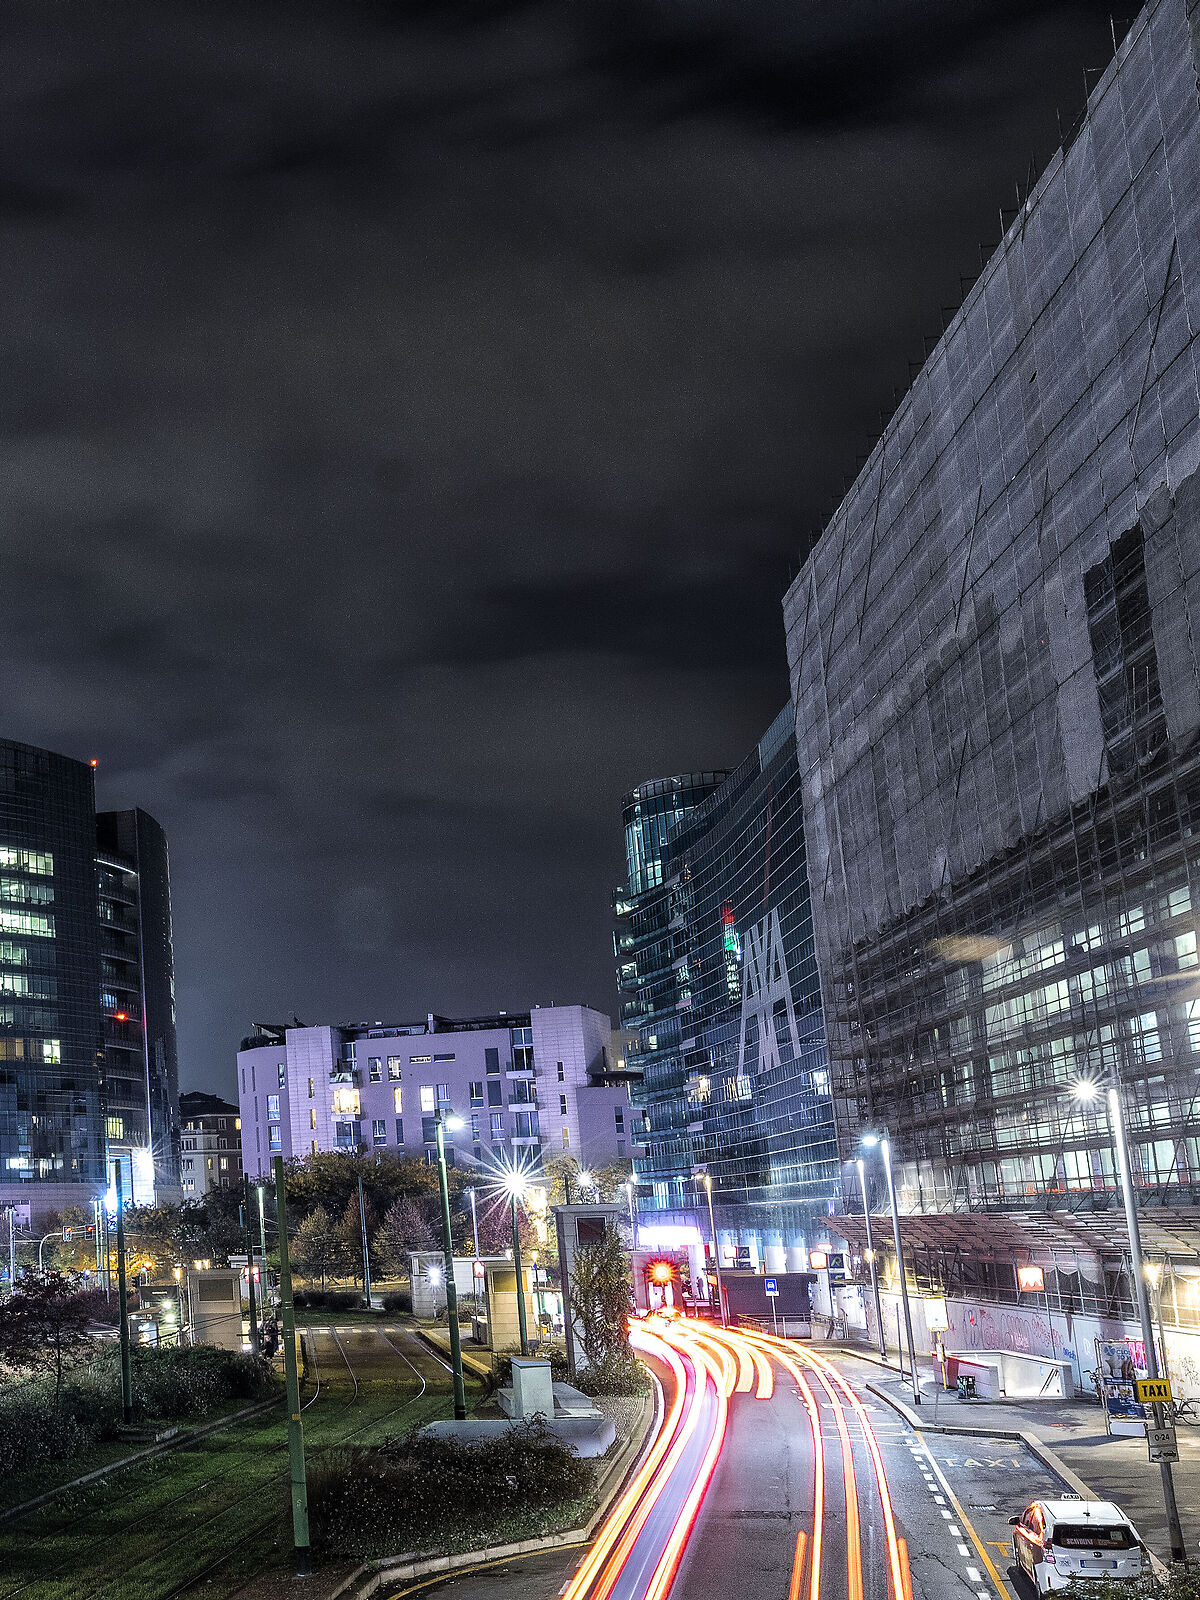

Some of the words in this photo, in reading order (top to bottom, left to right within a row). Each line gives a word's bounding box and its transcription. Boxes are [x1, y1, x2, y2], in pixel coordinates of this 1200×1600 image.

[1141, 1384, 1168, 1397] TAXI
[1154, 1433, 1170, 1441] 0-24
[937, 1458, 1021, 1468] TAXI
